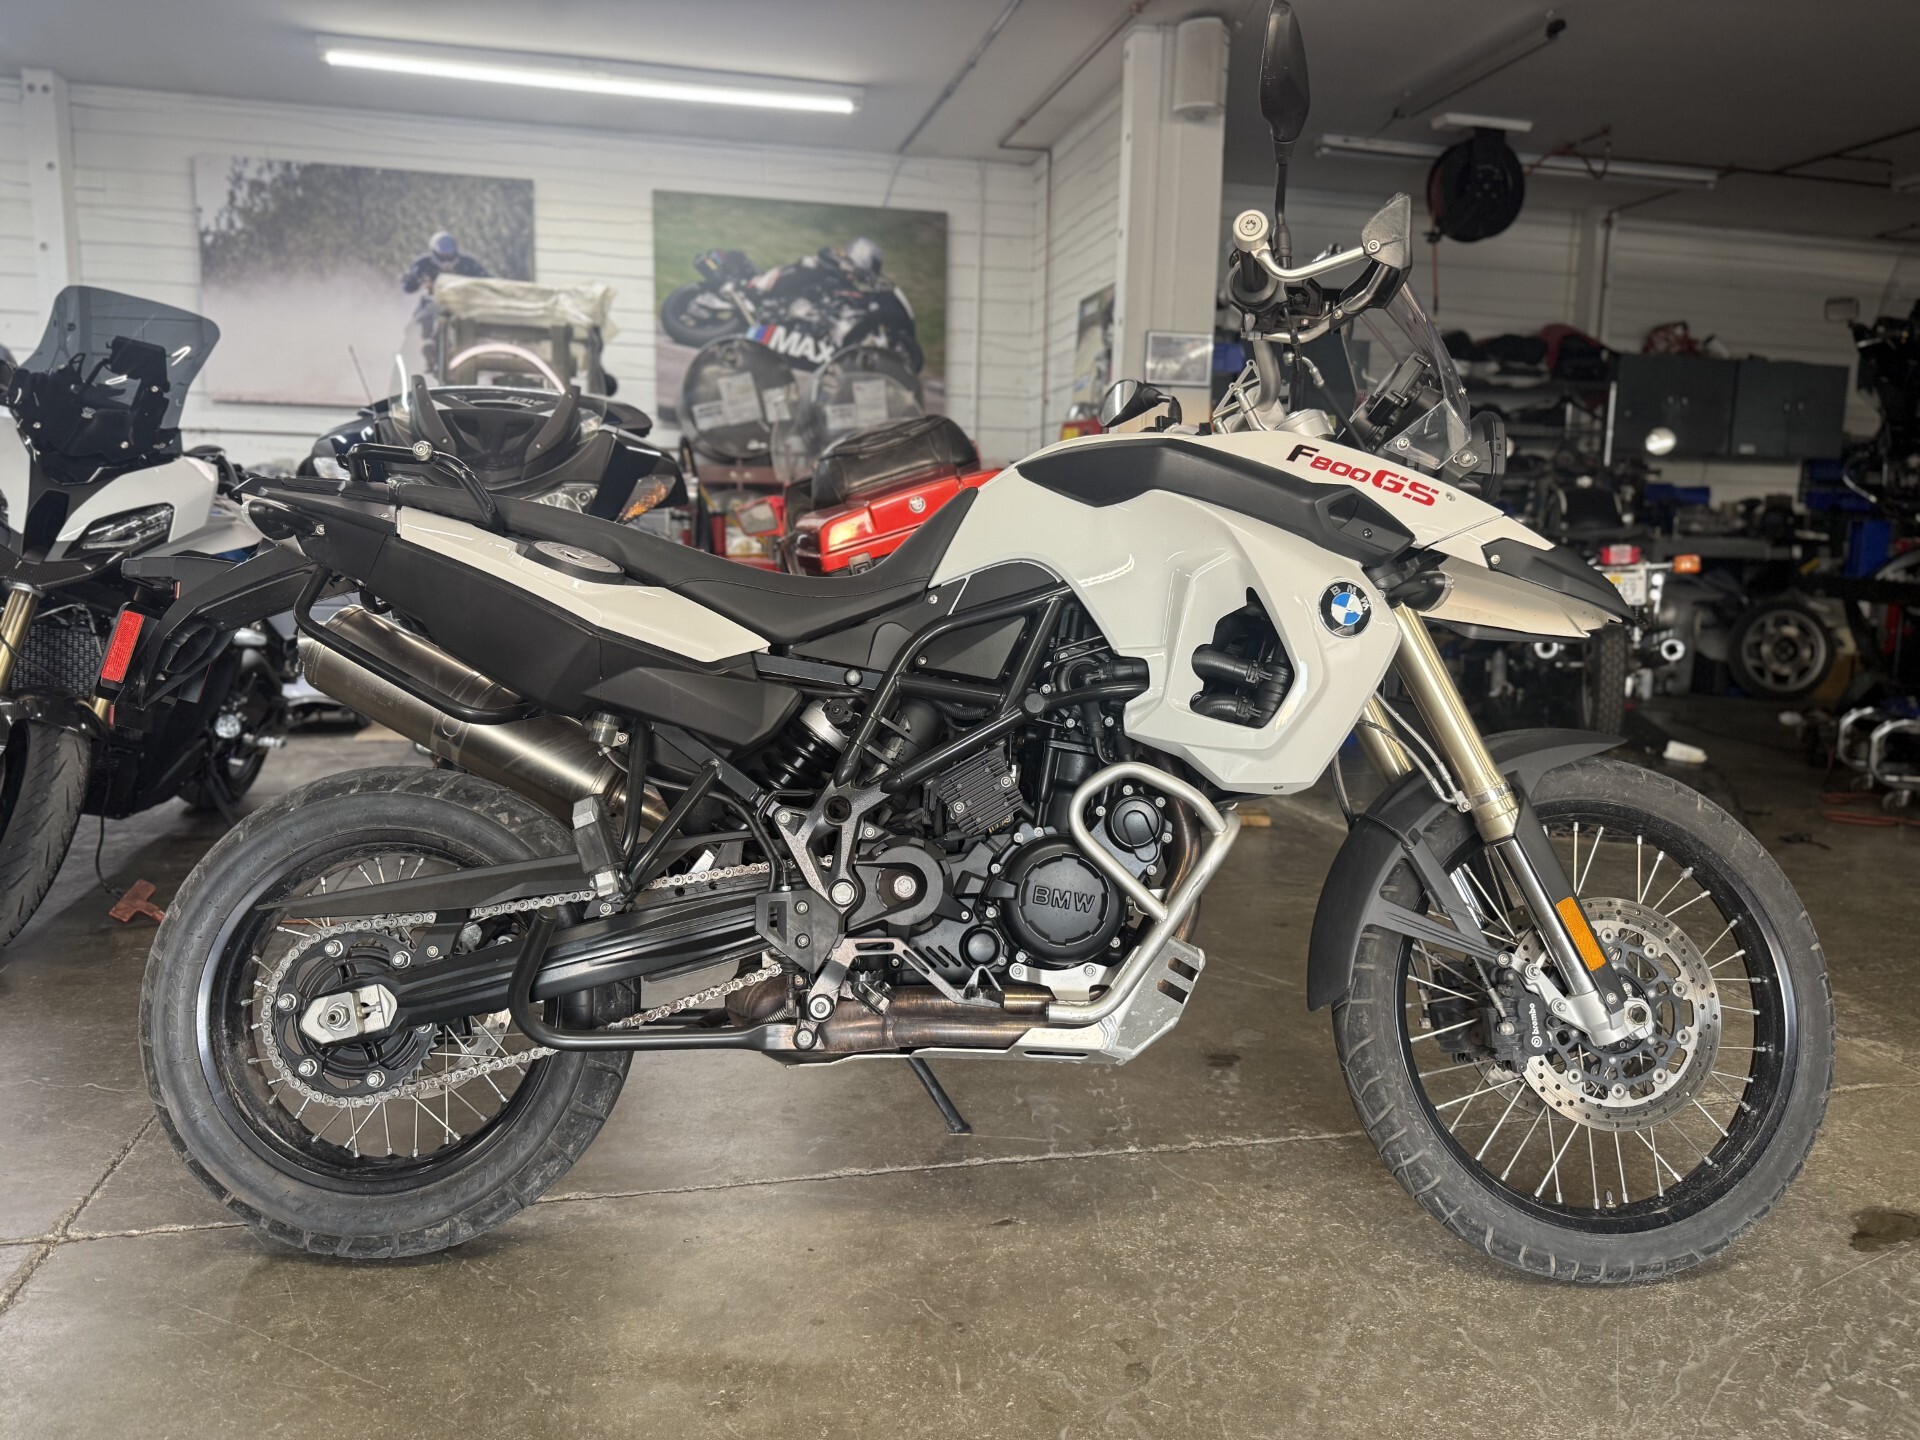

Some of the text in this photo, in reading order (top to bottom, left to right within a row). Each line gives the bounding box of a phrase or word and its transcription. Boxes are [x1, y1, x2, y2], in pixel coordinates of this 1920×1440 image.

[1330, 584, 1371, 611] BMW
[1032, 885, 1096, 913] BMW
[1528, 1002, 1540, 1035] brembo
